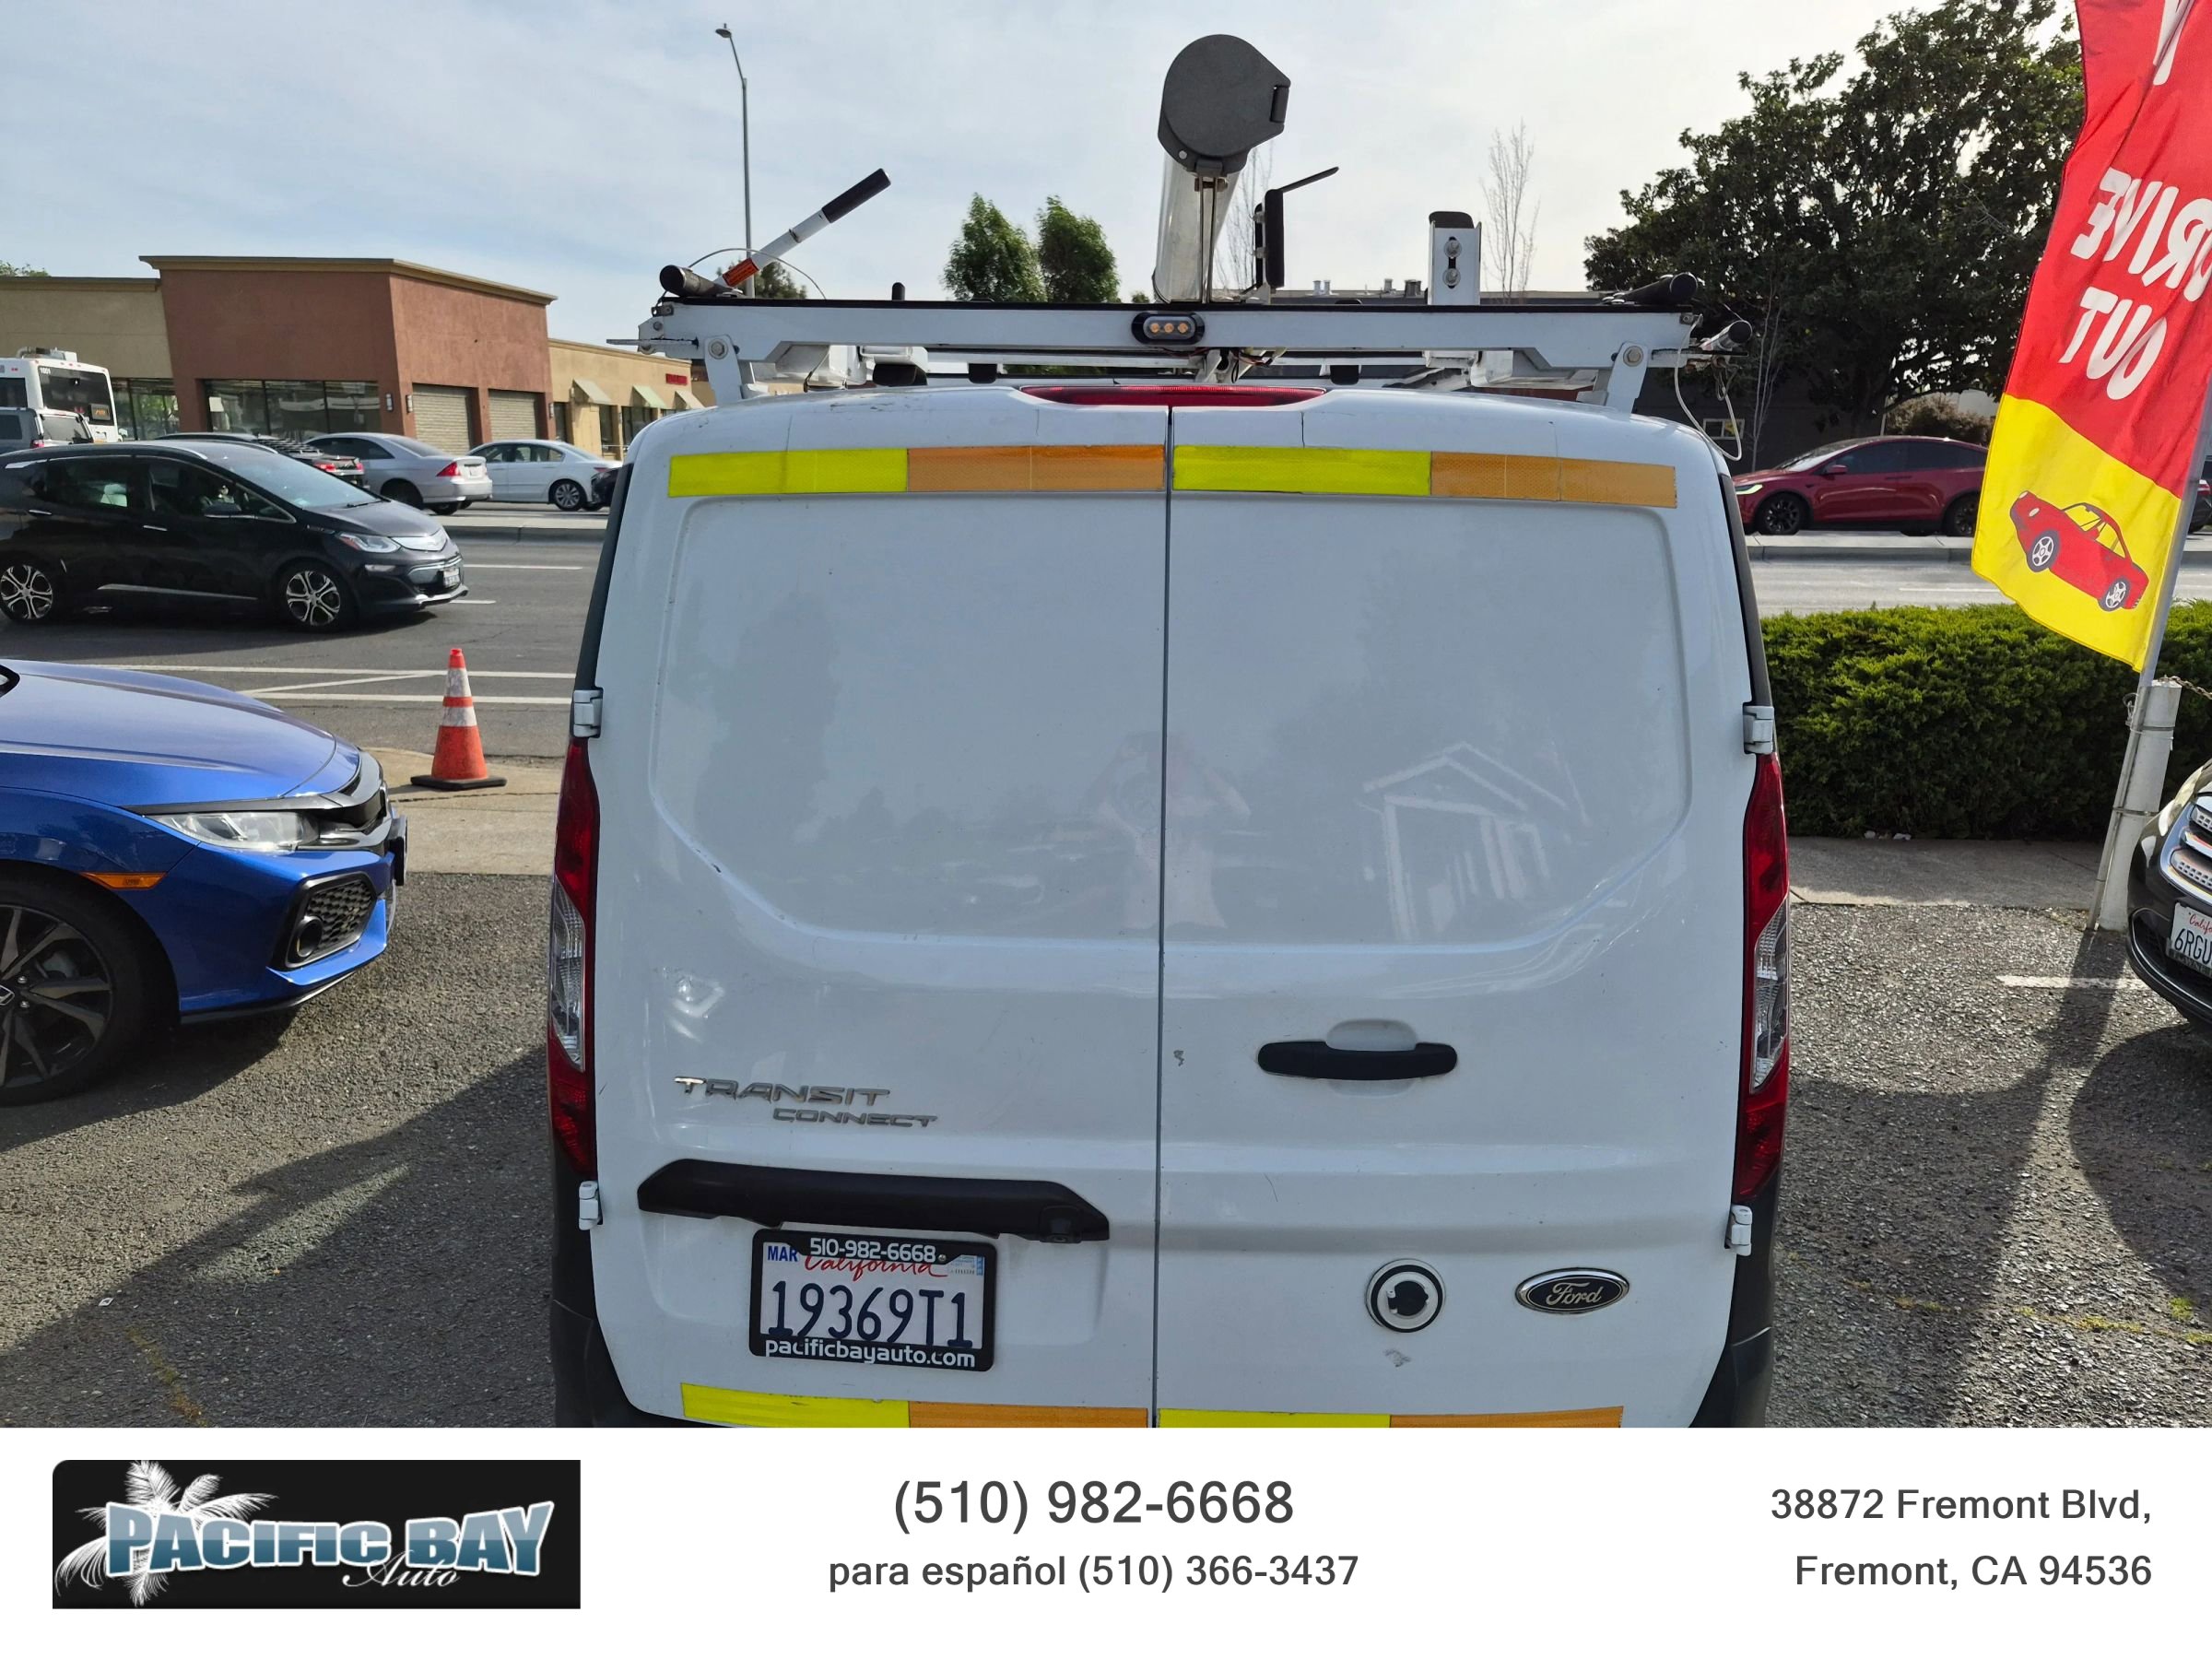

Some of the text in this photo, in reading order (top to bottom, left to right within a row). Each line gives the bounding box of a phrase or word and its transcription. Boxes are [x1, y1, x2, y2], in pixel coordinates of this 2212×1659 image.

[674, 1076, 891, 1106] TRANSIT
[773, 1108, 938, 1127] CONNECT
[767, 1245, 798, 1263] MAR
[809, 1237, 936, 1263] 510-982-6668
[1546, 1282, 1602, 1306] Ford
[768, 1280, 973, 1348] 19369T1
[765, 1339, 976, 1368] pacificbayauto.com
